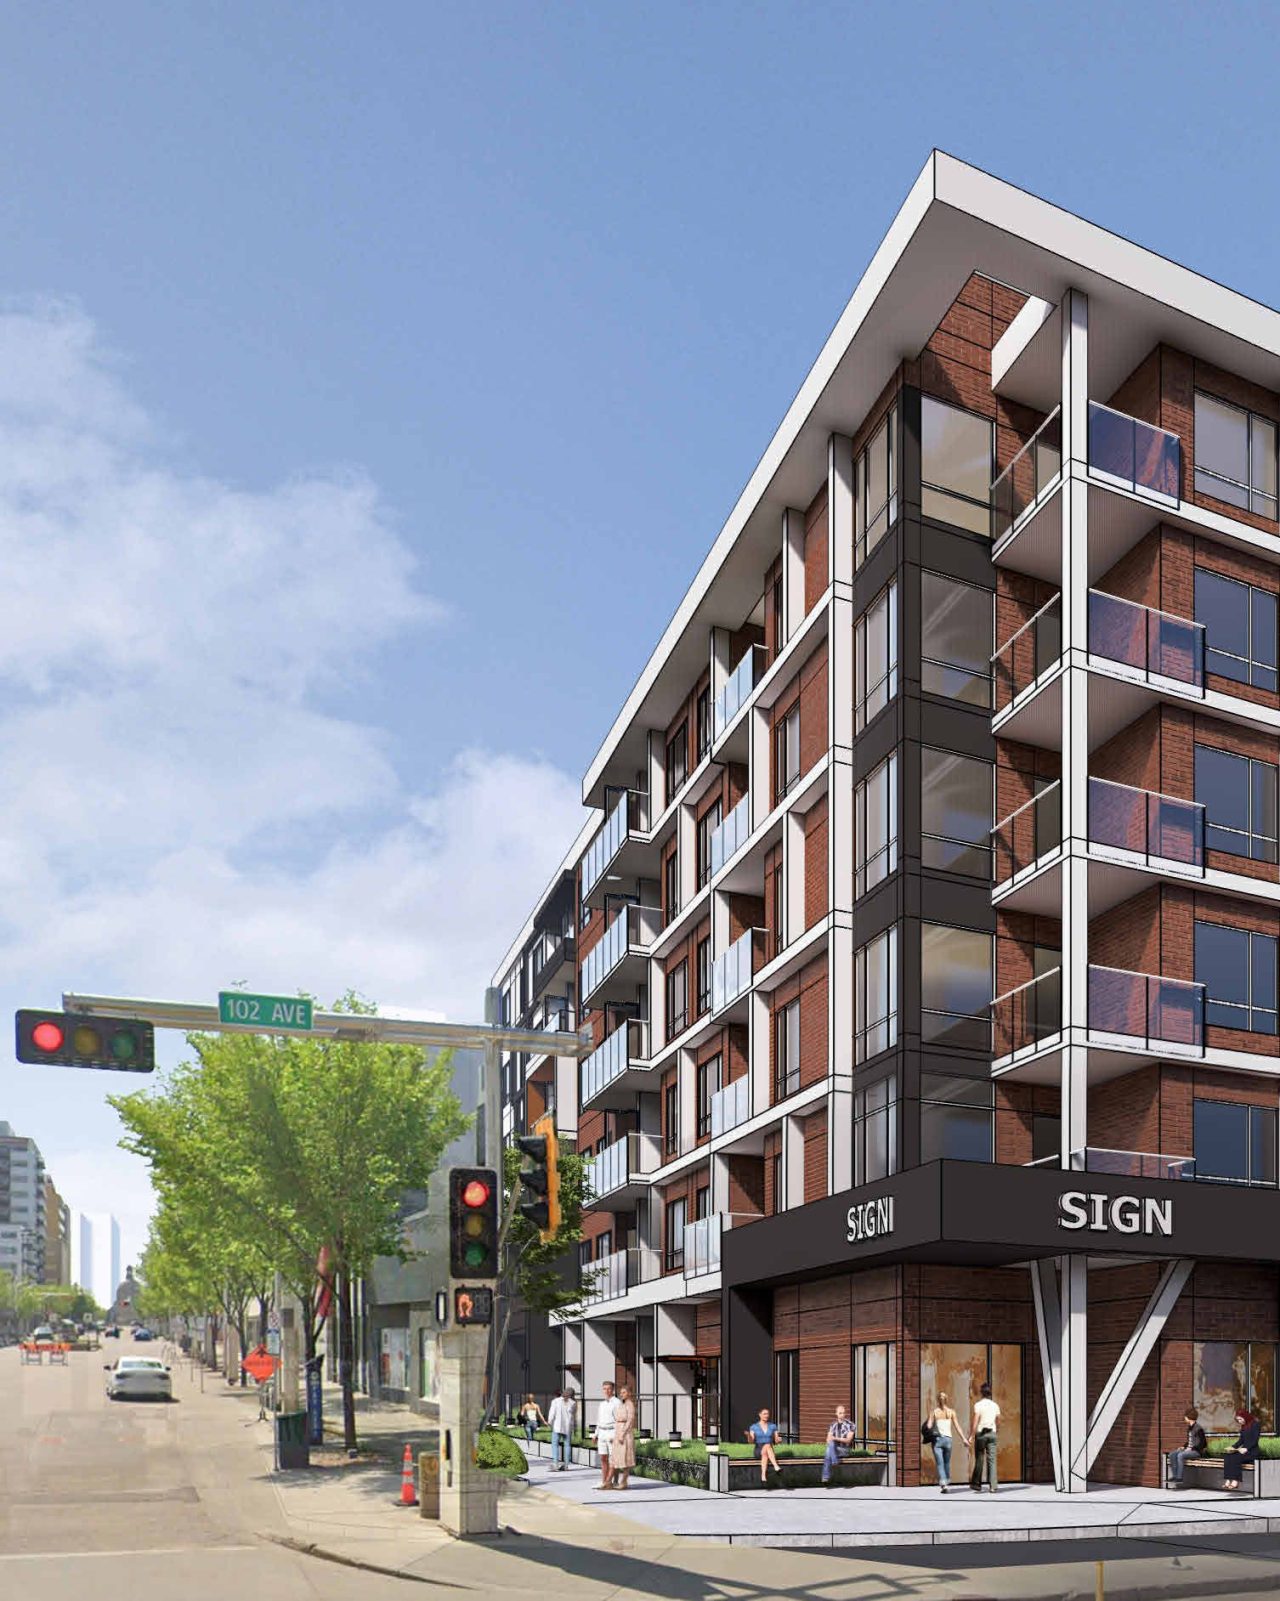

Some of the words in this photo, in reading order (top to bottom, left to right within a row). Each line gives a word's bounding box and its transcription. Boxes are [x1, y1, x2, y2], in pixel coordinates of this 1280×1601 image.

[227, 999, 260, 1020] 102
[272, 1003, 305, 1025] AVE
[847, 1196, 894, 1242] SIGN
[1058, 1191, 1172, 1235] SIGN
